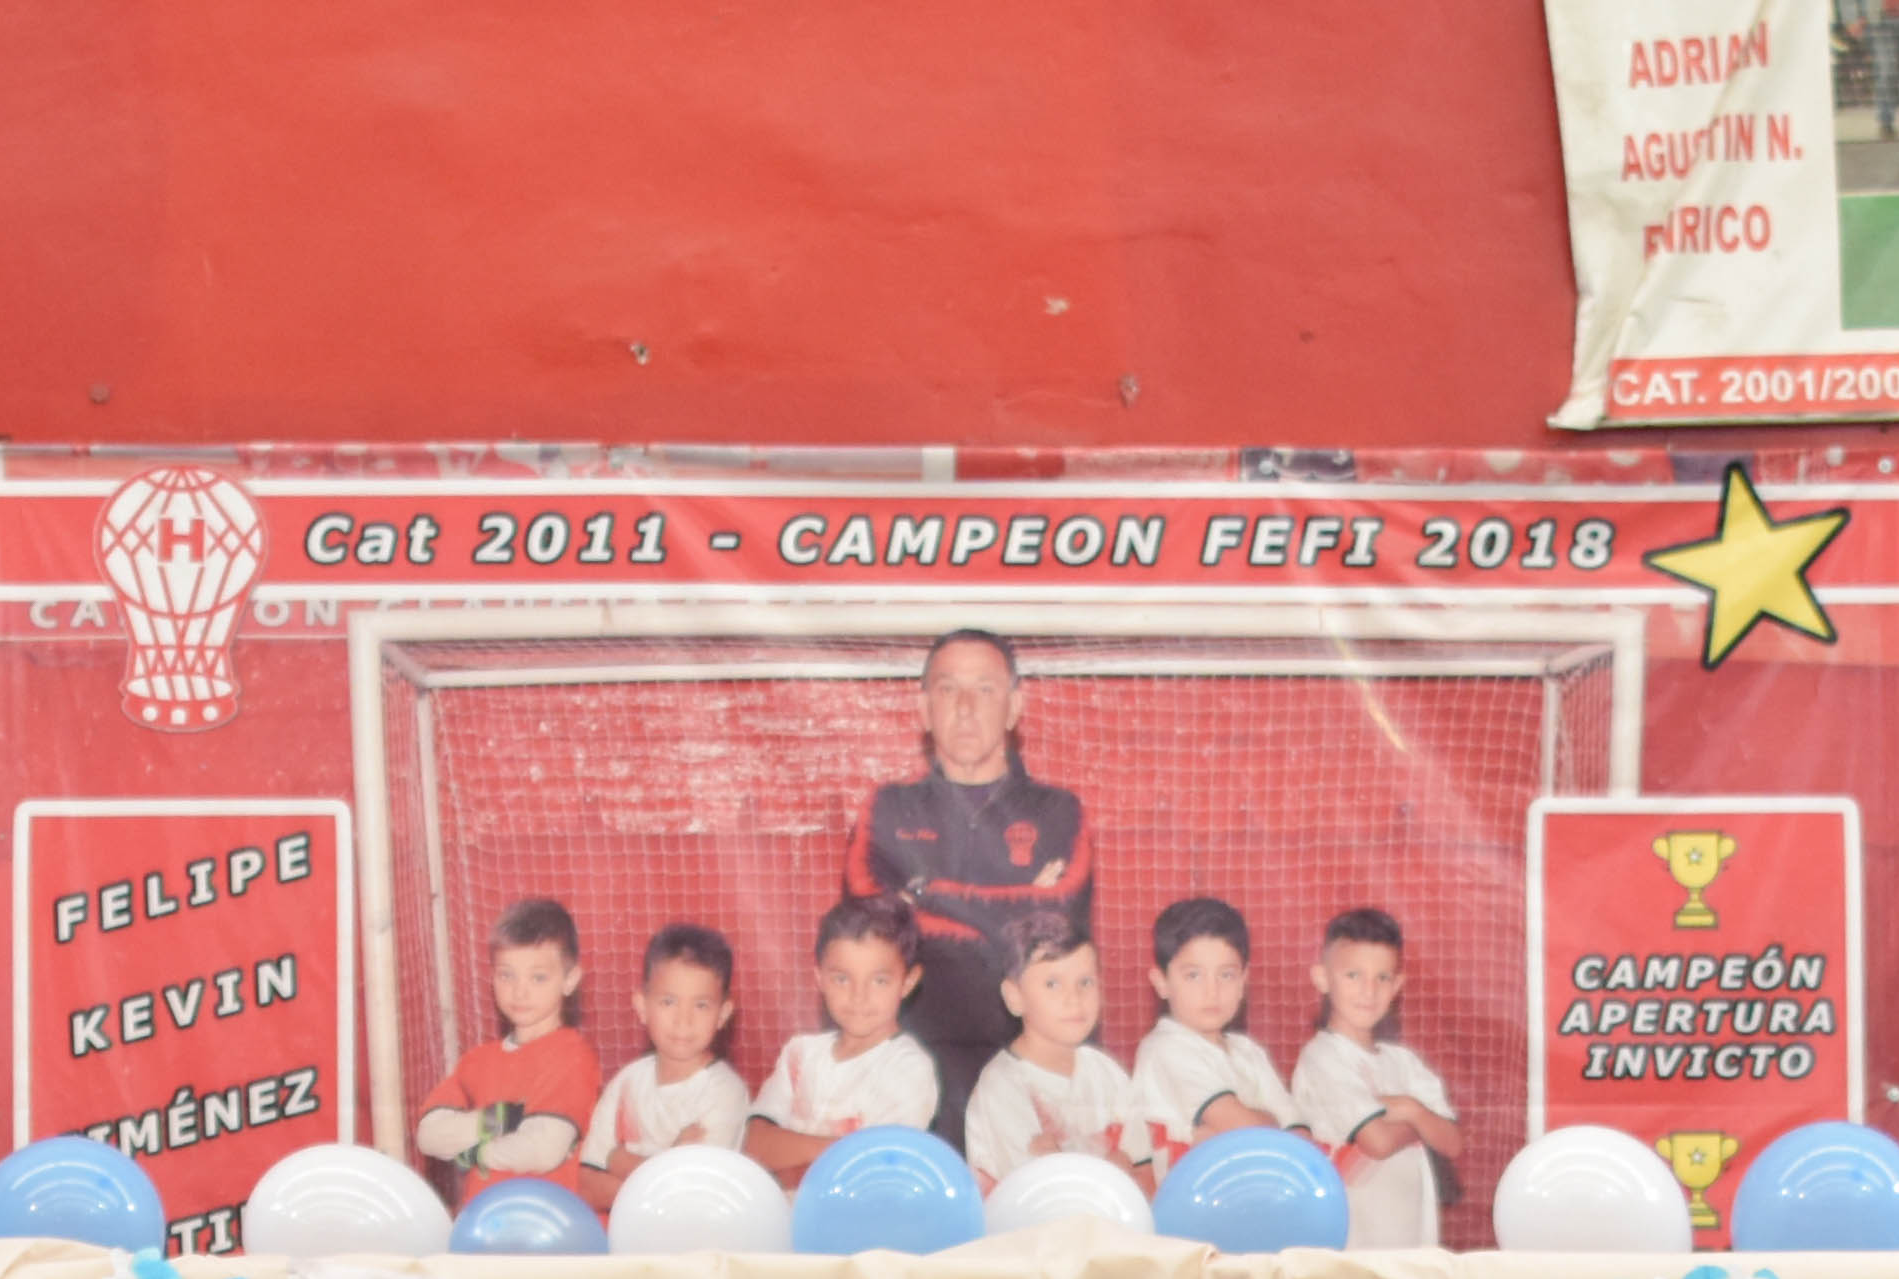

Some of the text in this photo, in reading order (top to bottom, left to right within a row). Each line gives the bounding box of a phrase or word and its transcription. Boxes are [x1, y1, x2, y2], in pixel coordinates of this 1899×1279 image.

[1629, 21, 1771, 89] ADRIAN
[1766, 112, 1805, 163] N.
[1613, 370, 1708, 406] CAT.
[304, 512, 439, 565] Cat
[472, 512, 669, 565] 2011
[777, 514, 1165, 567] CAMPEON
[1201, 515, 1384, 568] FEFI
[1416, 518, 1616, 570] 2018
[54, 831, 312, 945] FELIPE
[1572, 943, 1826, 991] CAMPEÓN
[70, 953, 300, 1058] KEVIN
[1558, 998, 1836, 1036] APERTURA
[1582, 1041, 1815, 1080] INVICTO
[67, 1066, 320, 1159] IMÉNEZ
